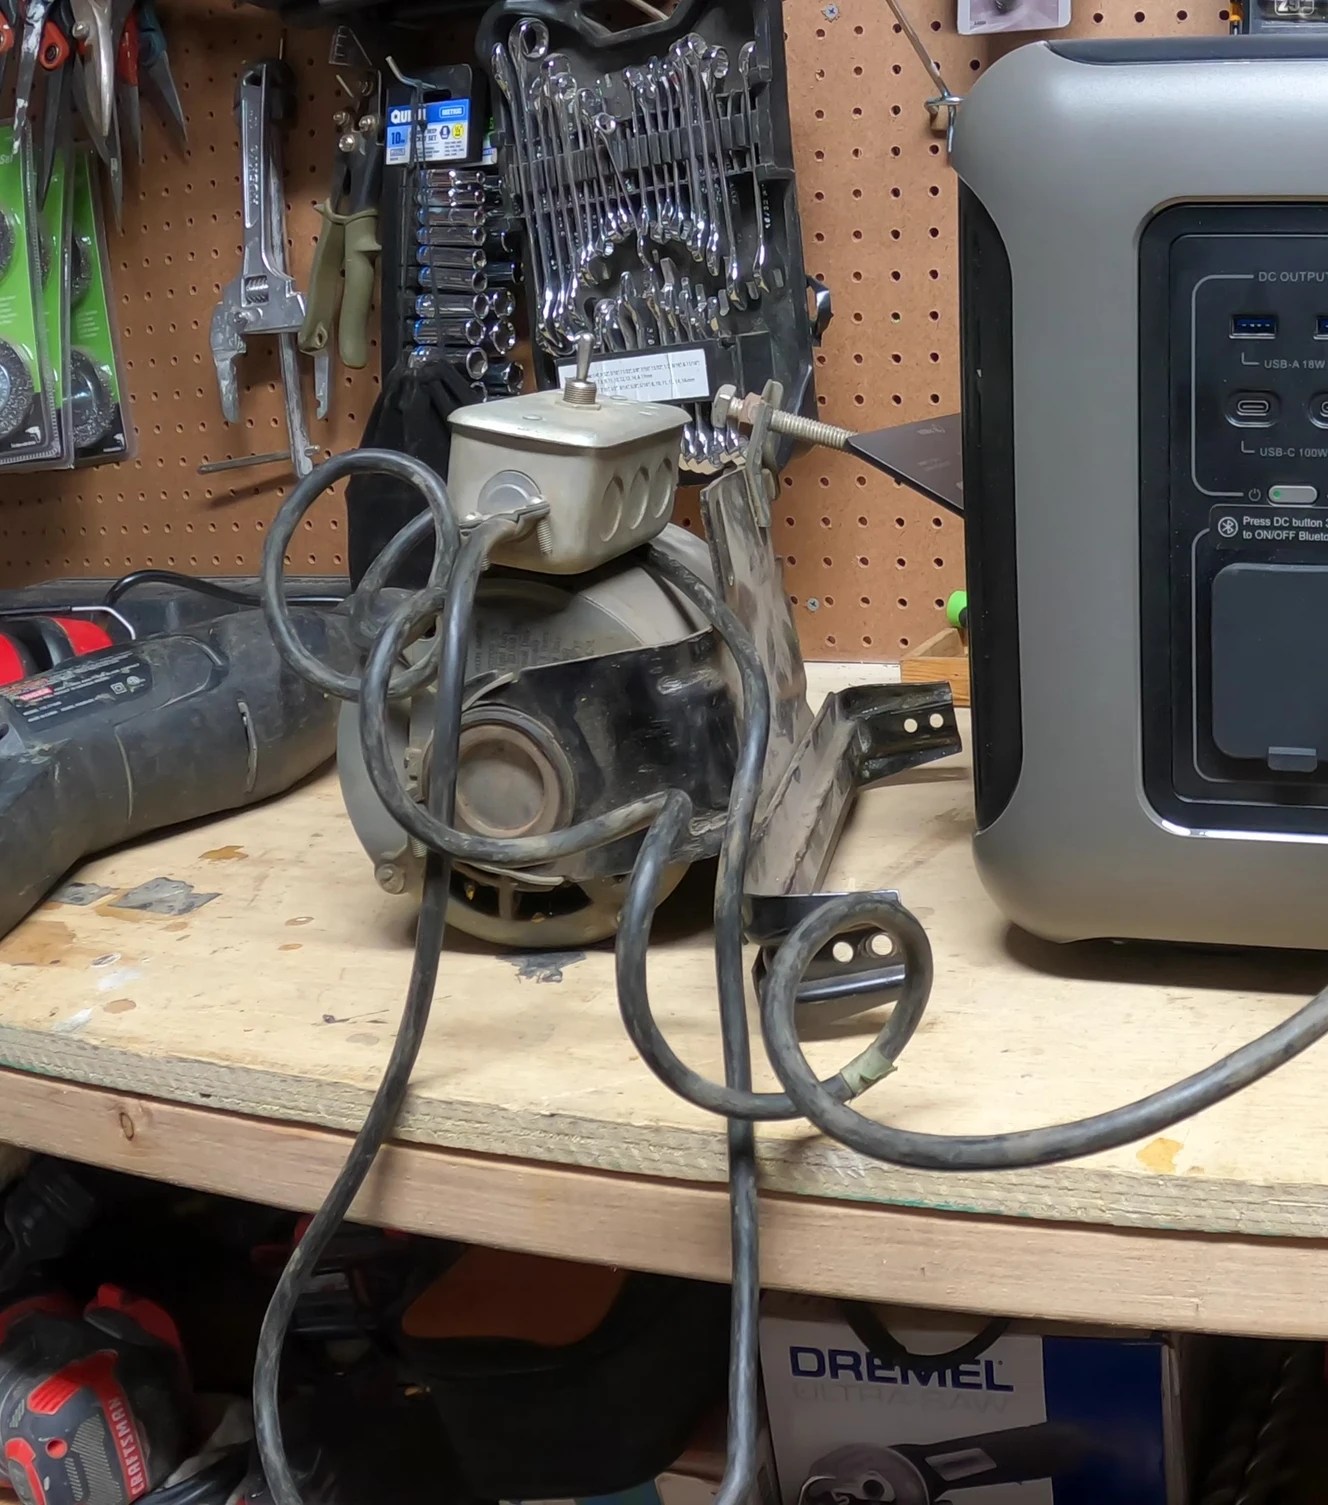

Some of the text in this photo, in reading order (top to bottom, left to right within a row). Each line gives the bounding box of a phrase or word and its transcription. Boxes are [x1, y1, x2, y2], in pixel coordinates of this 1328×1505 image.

[1258, 271, 1277, 282] DC
[1264, 359, 1326, 369] USB-A 18W
[1260, 447, 1328, 458] USB-C 100W
[1243, 516, 1271, 526] Press
[1273, 517, 1290, 527] DC
[1292, 517, 1323, 528] button
[1243, 530, 1252, 539] to
[1254, 530, 1296, 541] ON/OFF
[789, 1345, 1015, 1392] DREMEL
[108, 1396, 146, 1495] CRAFTSMAN
